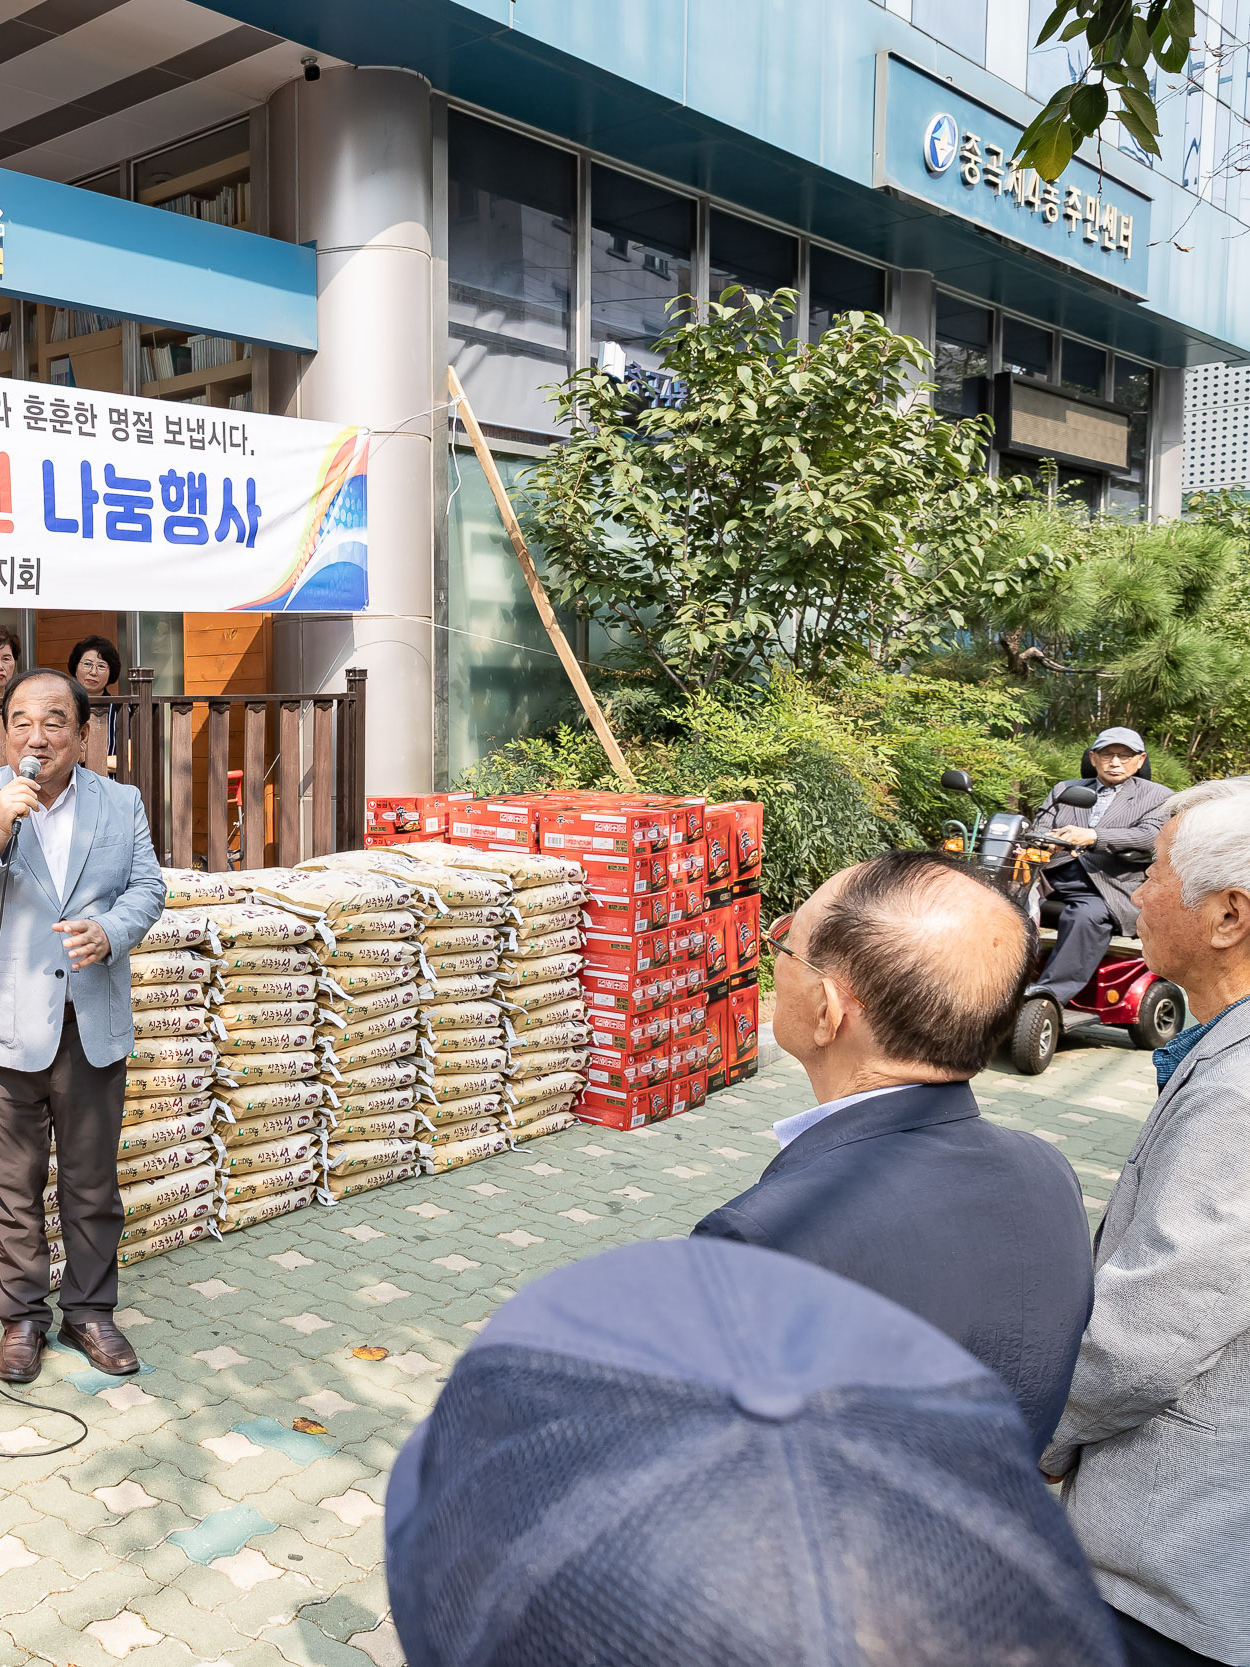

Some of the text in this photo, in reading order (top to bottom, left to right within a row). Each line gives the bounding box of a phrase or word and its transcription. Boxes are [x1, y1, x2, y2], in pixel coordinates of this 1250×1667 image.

[24, 395, 97, 437] 훈훈한
[109, 408, 153, 444] 명절
[164, 416, 254, 455] 보냅시다.
[42, 460, 261, 548] 나눔행사
